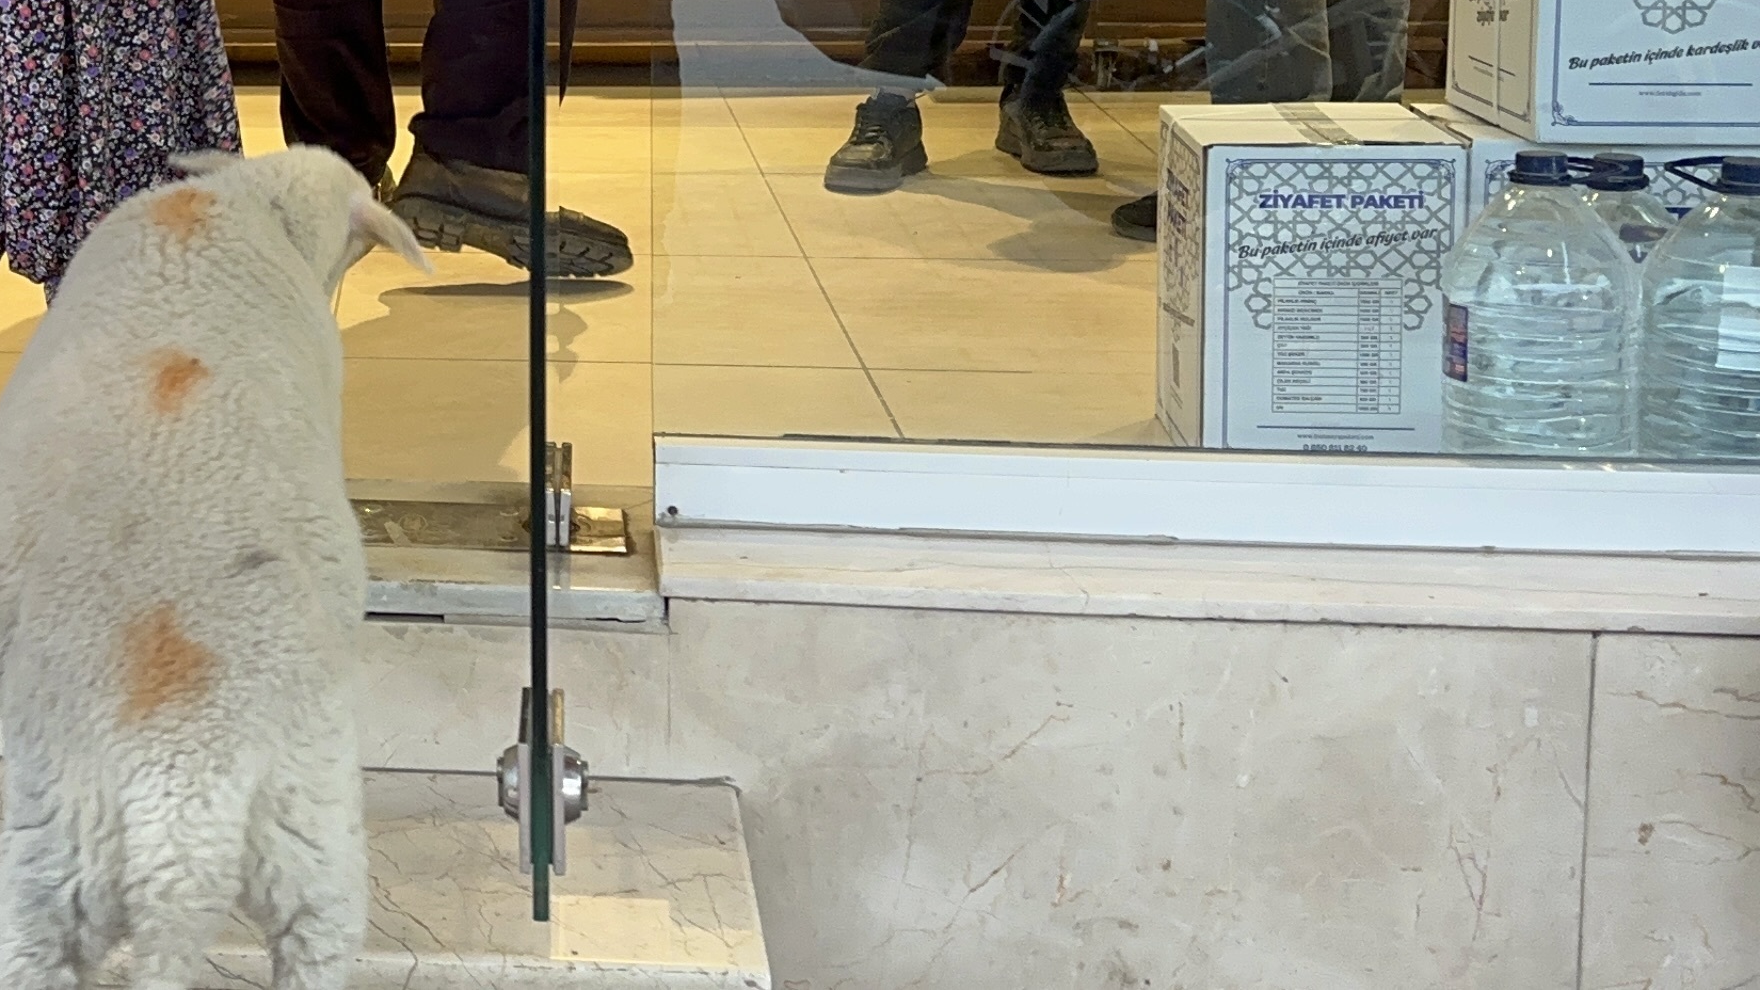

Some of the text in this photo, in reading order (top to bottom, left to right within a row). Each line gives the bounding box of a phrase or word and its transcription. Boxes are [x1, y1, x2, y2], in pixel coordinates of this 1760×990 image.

[1568, 56, 1588, 70] Bu
[1589, 50, 1641, 70] paketin
[1644, 46, 1684, 65] içinde
[1686, 38, 1749, 56] kardeşlik
[1259, 189, 1424, 209] ZİYAFET PAKETİ
[1238, 228, 1438, 259] Bu paketin içinde afiyet var
